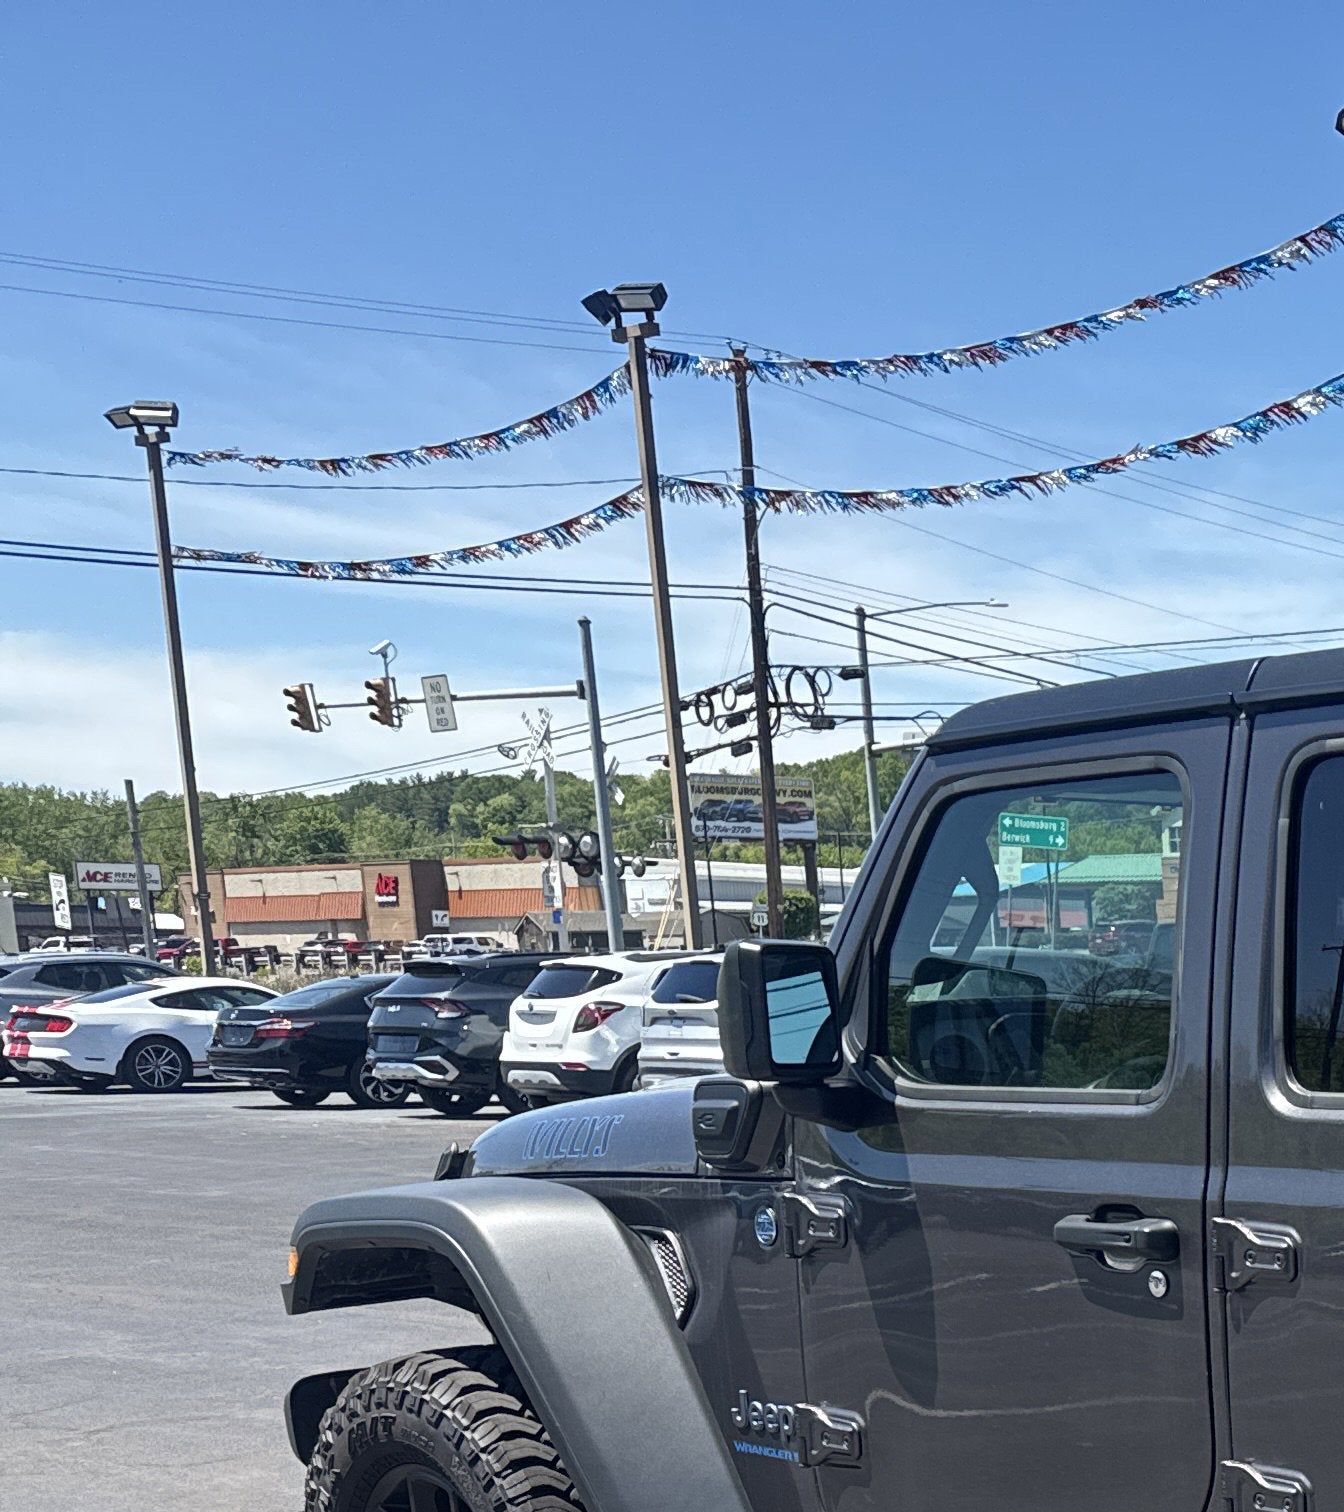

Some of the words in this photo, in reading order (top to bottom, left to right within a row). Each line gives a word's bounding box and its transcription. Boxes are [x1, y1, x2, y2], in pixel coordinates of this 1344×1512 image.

[429, 681, 442, 693] NO
[435, 706, 446, 715] ON
[436, 717, 450, 727] RED
[1014, 817, 1057, 832] Bloomsburg
[1001, 831, 1031, 843] Berwick
[81, 870, 114, 884] ACE
[114, 871, 153, 879] RENO
[375, 873, 399, 895] ACE
[730, 1389, 795, 1448] Jeep
[733, 1440, 796, 1462] WRANGLER
